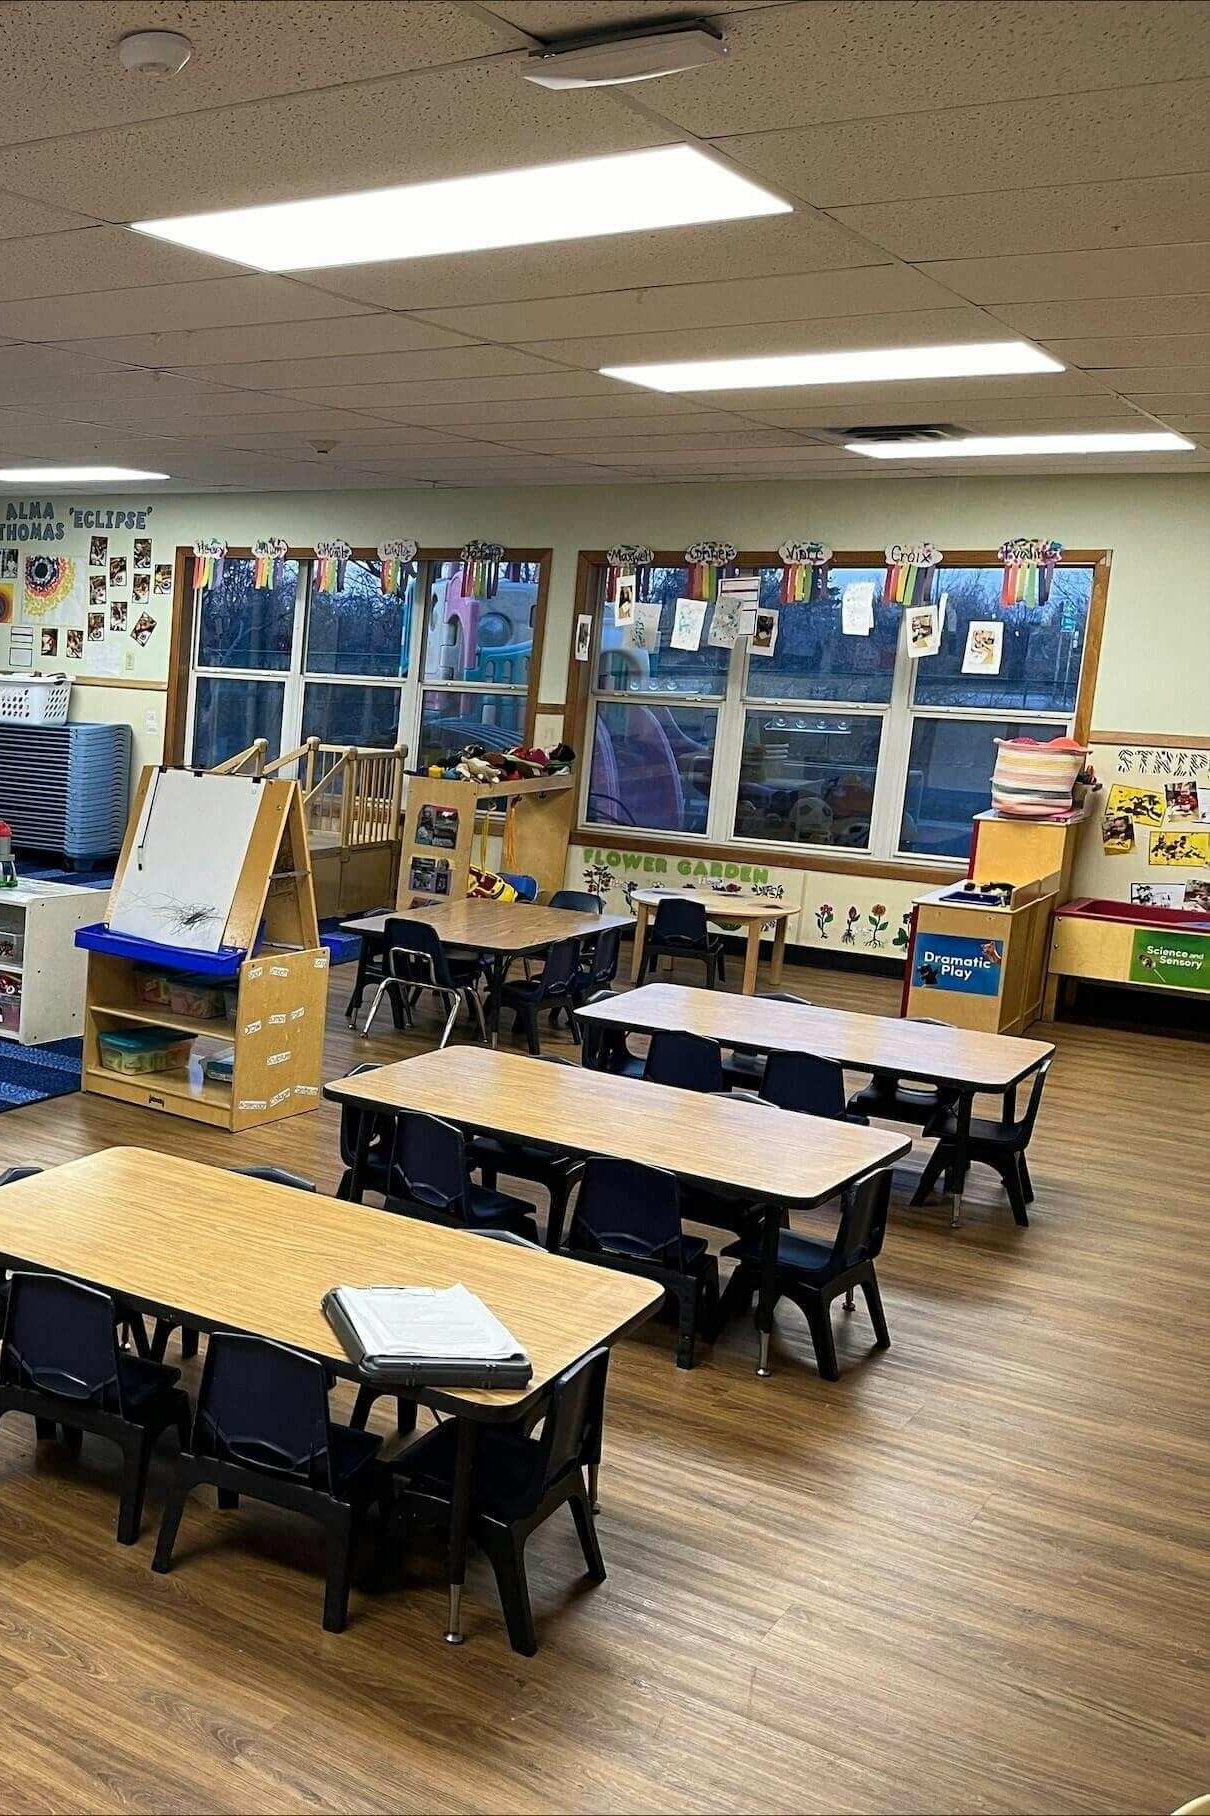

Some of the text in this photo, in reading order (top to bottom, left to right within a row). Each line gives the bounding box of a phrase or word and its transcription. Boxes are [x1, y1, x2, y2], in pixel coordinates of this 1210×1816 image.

[6, 502, 54, 521] ALMA
[70, 506, 152, 530] 'ECLIPSE'
[891, 545, 931, 563] Croix
[583, 849, 667, 873] FLOWER
[677, 859, 769, 885] GARDEN
[924, 951, 991, 969] Dramatic
[1146, 945, 1189, 958] Science
[1159, 955, 1203, 970] Sensory
[941, 965, 972, 981] Play
